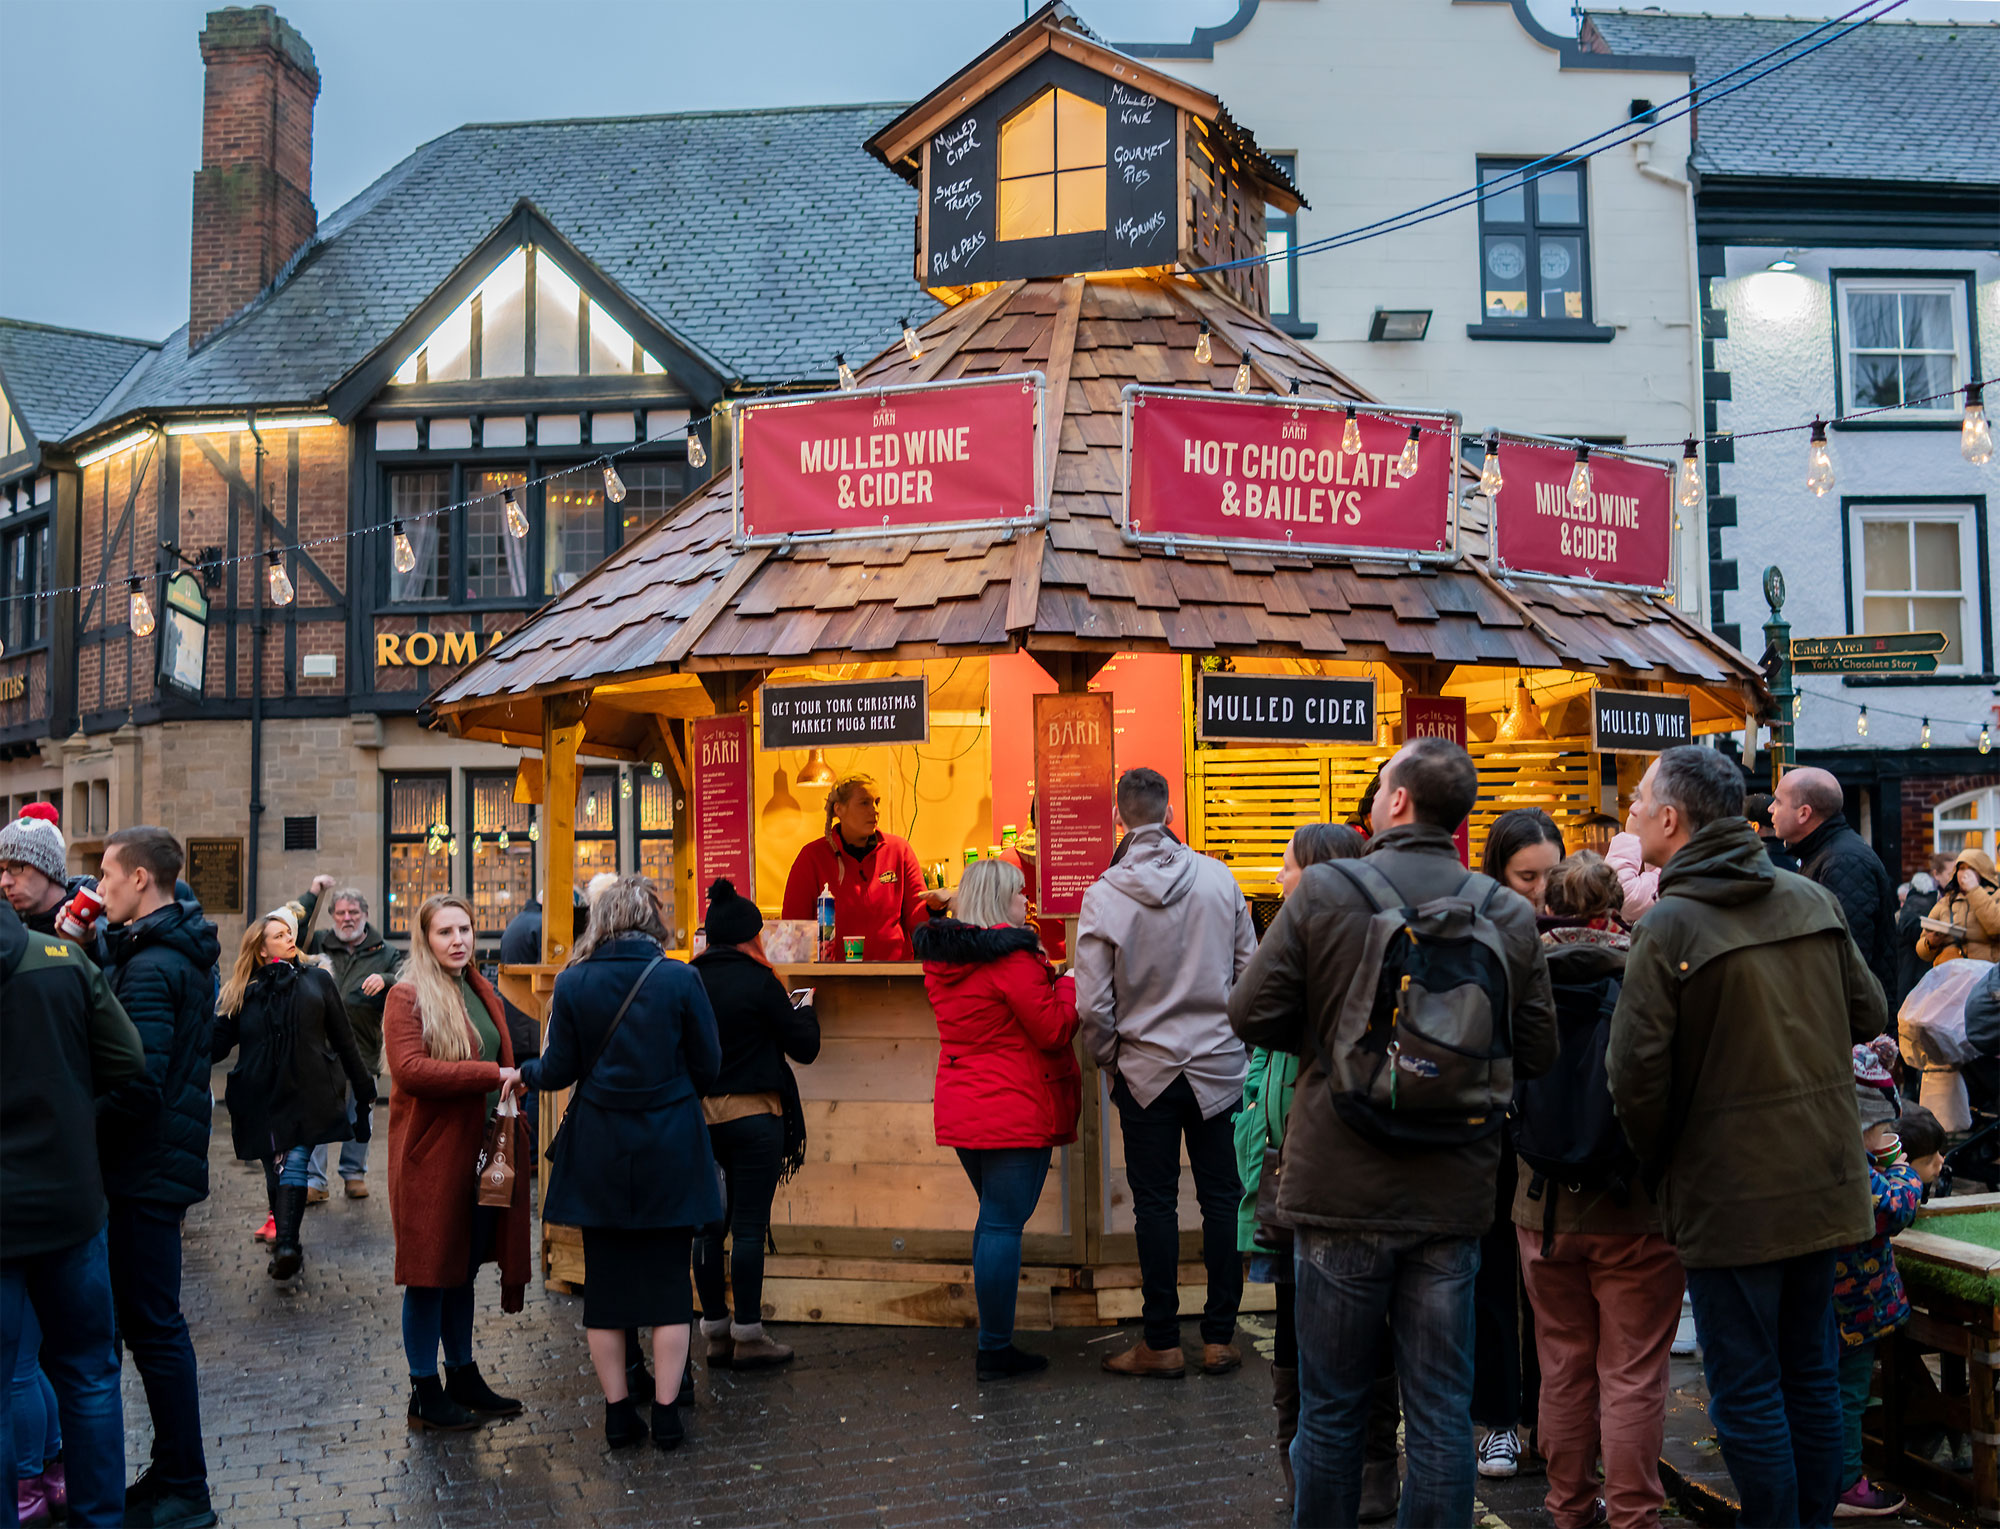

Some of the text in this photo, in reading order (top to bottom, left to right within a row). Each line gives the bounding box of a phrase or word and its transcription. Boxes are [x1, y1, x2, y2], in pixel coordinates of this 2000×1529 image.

[1110, 84, 1156, 110] MULLED
[1121, 108, 1152, 124] WINE
[934, 118, 977, 154] MULLED
[946, 138, 981, 166] CIDER
[1114, 138, 1170, 168] GOURMET
[934, 178, 973, 204] SWEET
[1123, 164, 1150, 190] PIES
[944, 190, 982, 220] TREATS
[1128, 210, 1166, 248] DRINKS
[960, 230, 986, 268] PEAS
[1282, 426, 1307, 440] BARN
[800, 426, 970, 474] MULLED WINE
[1184, 438, 1401, 488] HOT CHOCOLATE
[837, 470, 933, 509] & CIDER
[1221, 480, 1362, 526] & BAILEYS
[1599, 492, 1640, 530] WINE
[1560, 522, 1617, 563] & CIDER
[1794, 641, 1863, 655] Castle Area
[1811, 659, 1918, 670] York's Chocolate Story
[772, 695, 917, 716] GET YOUR YORK CHRISTMAS
[1208, 695, 1366, 725] MULLED CIDER
[792, 715, 896, 734] MARKET MUGS HERE
[1048, 720, 1100, 747] BARN
[1416, 722, 1456, 744] BARN
[1601, 709, 1685, 738] MULLED WINE
[702, 740, 739, 767] BARN
